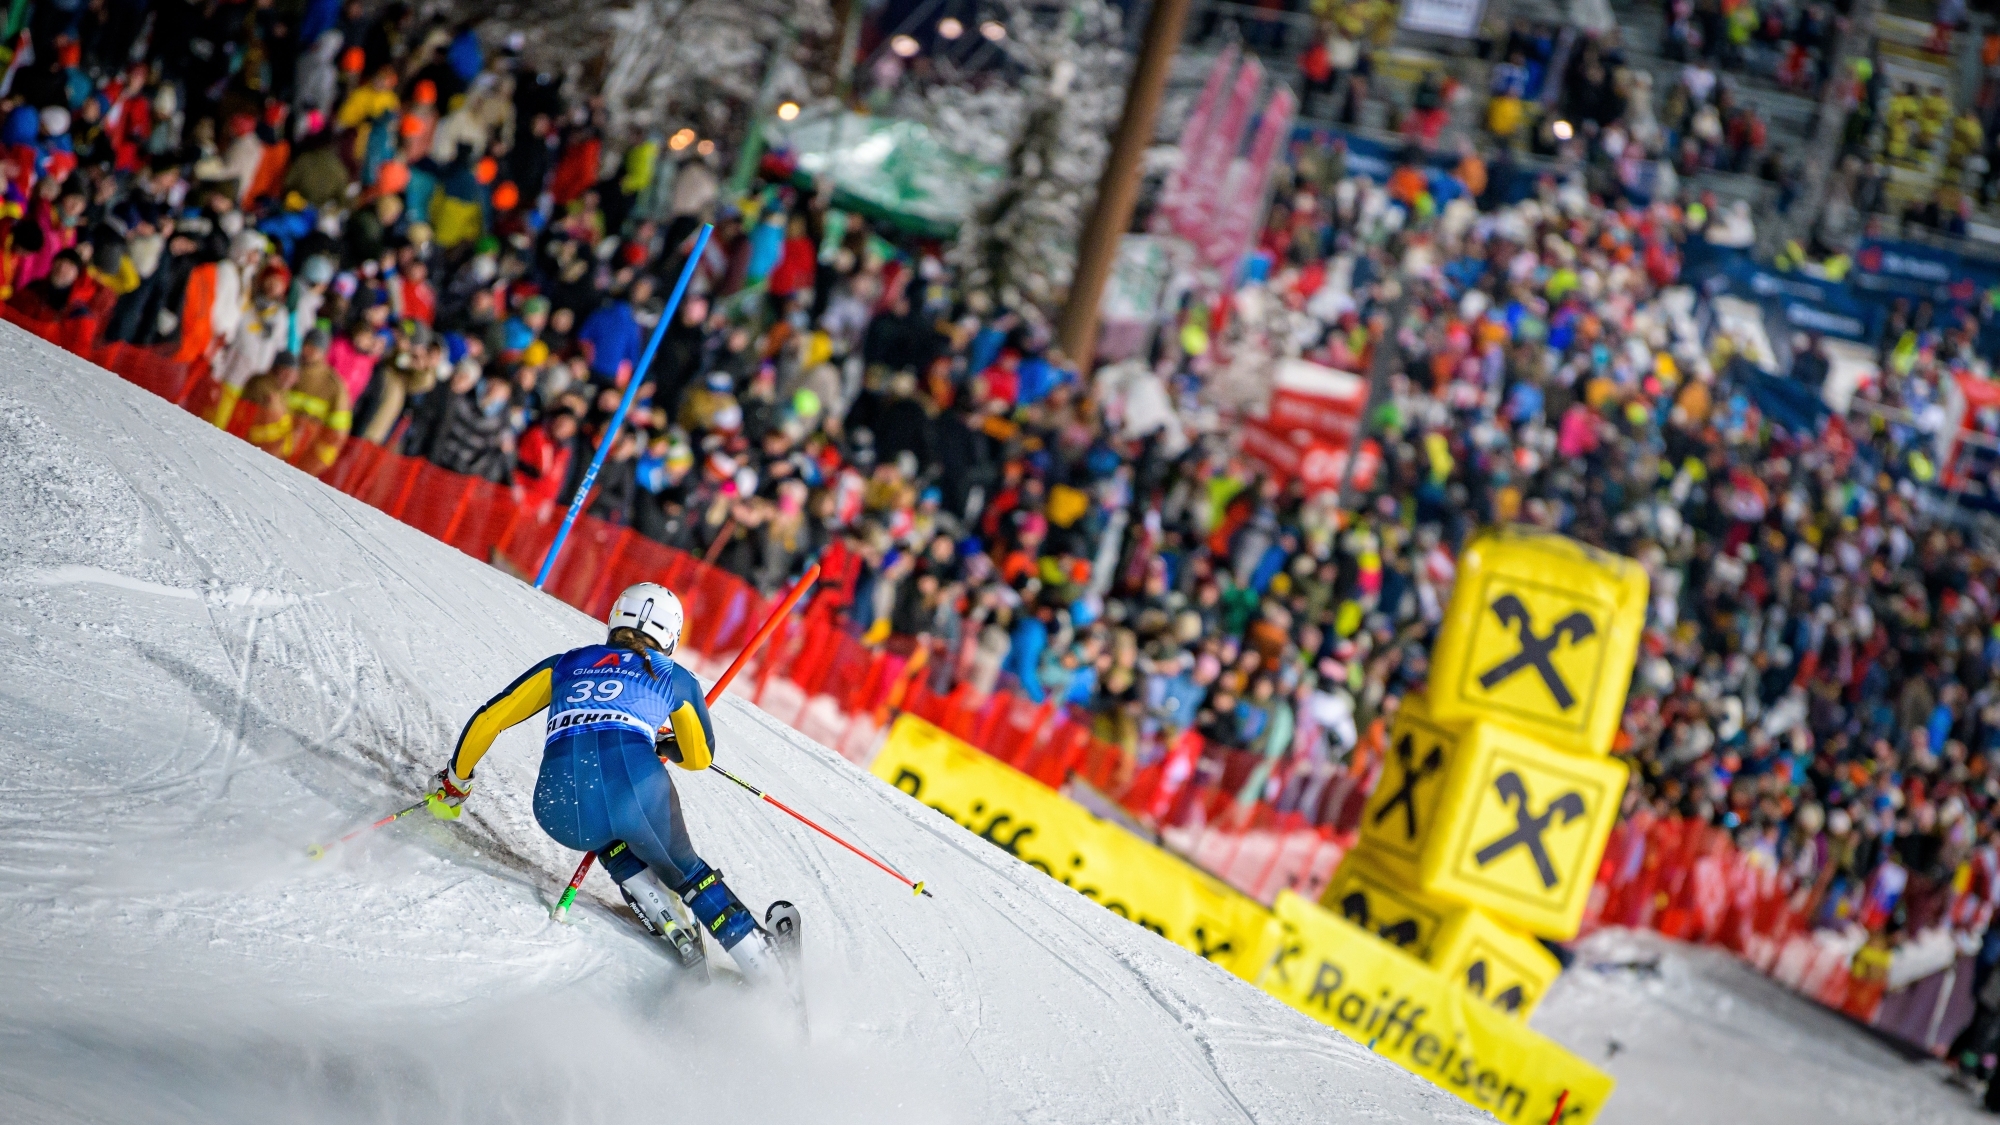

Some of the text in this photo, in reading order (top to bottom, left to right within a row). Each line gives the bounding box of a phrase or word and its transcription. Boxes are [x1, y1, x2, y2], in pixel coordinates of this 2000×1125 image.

[592, 652, 635, 668] A1
[566, 680, 624, 703] 39
[610, 842, 627, 857] LEKI
[699, 874, 716, 890] LEKI
[711, 913, 726, 932] LEKI
[1306, 959, 1528, 1118] Raiffeisen
